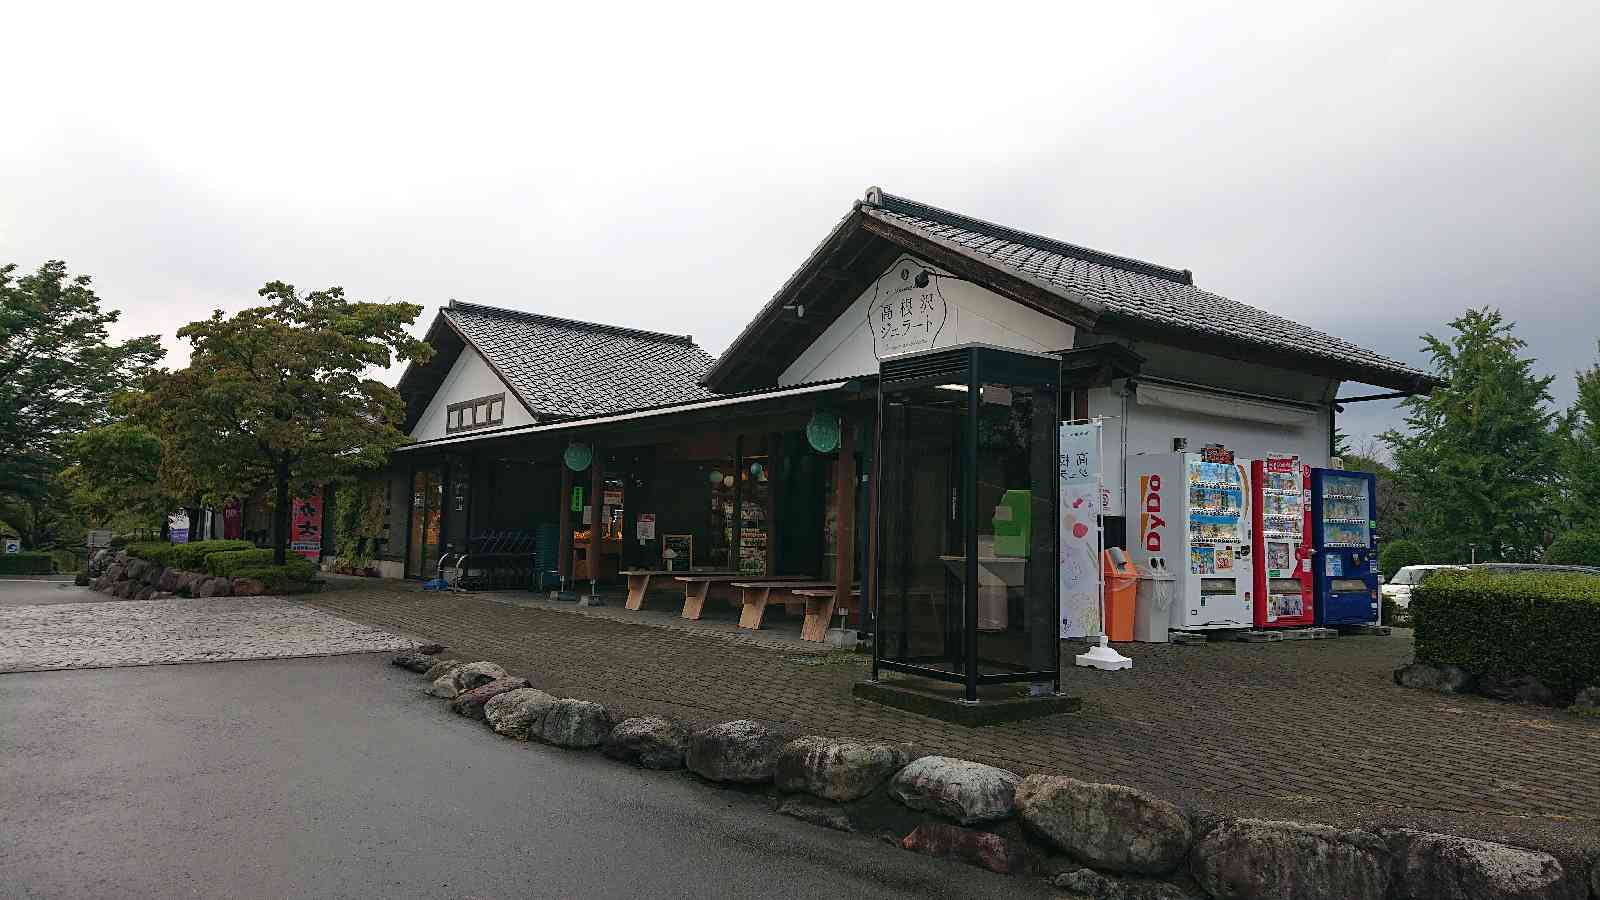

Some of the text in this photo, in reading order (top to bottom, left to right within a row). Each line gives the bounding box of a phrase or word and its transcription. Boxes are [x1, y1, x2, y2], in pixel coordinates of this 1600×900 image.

[881, 314, 933, 339] ジェラート
[1147, 474, 1166, 551] DyDo
